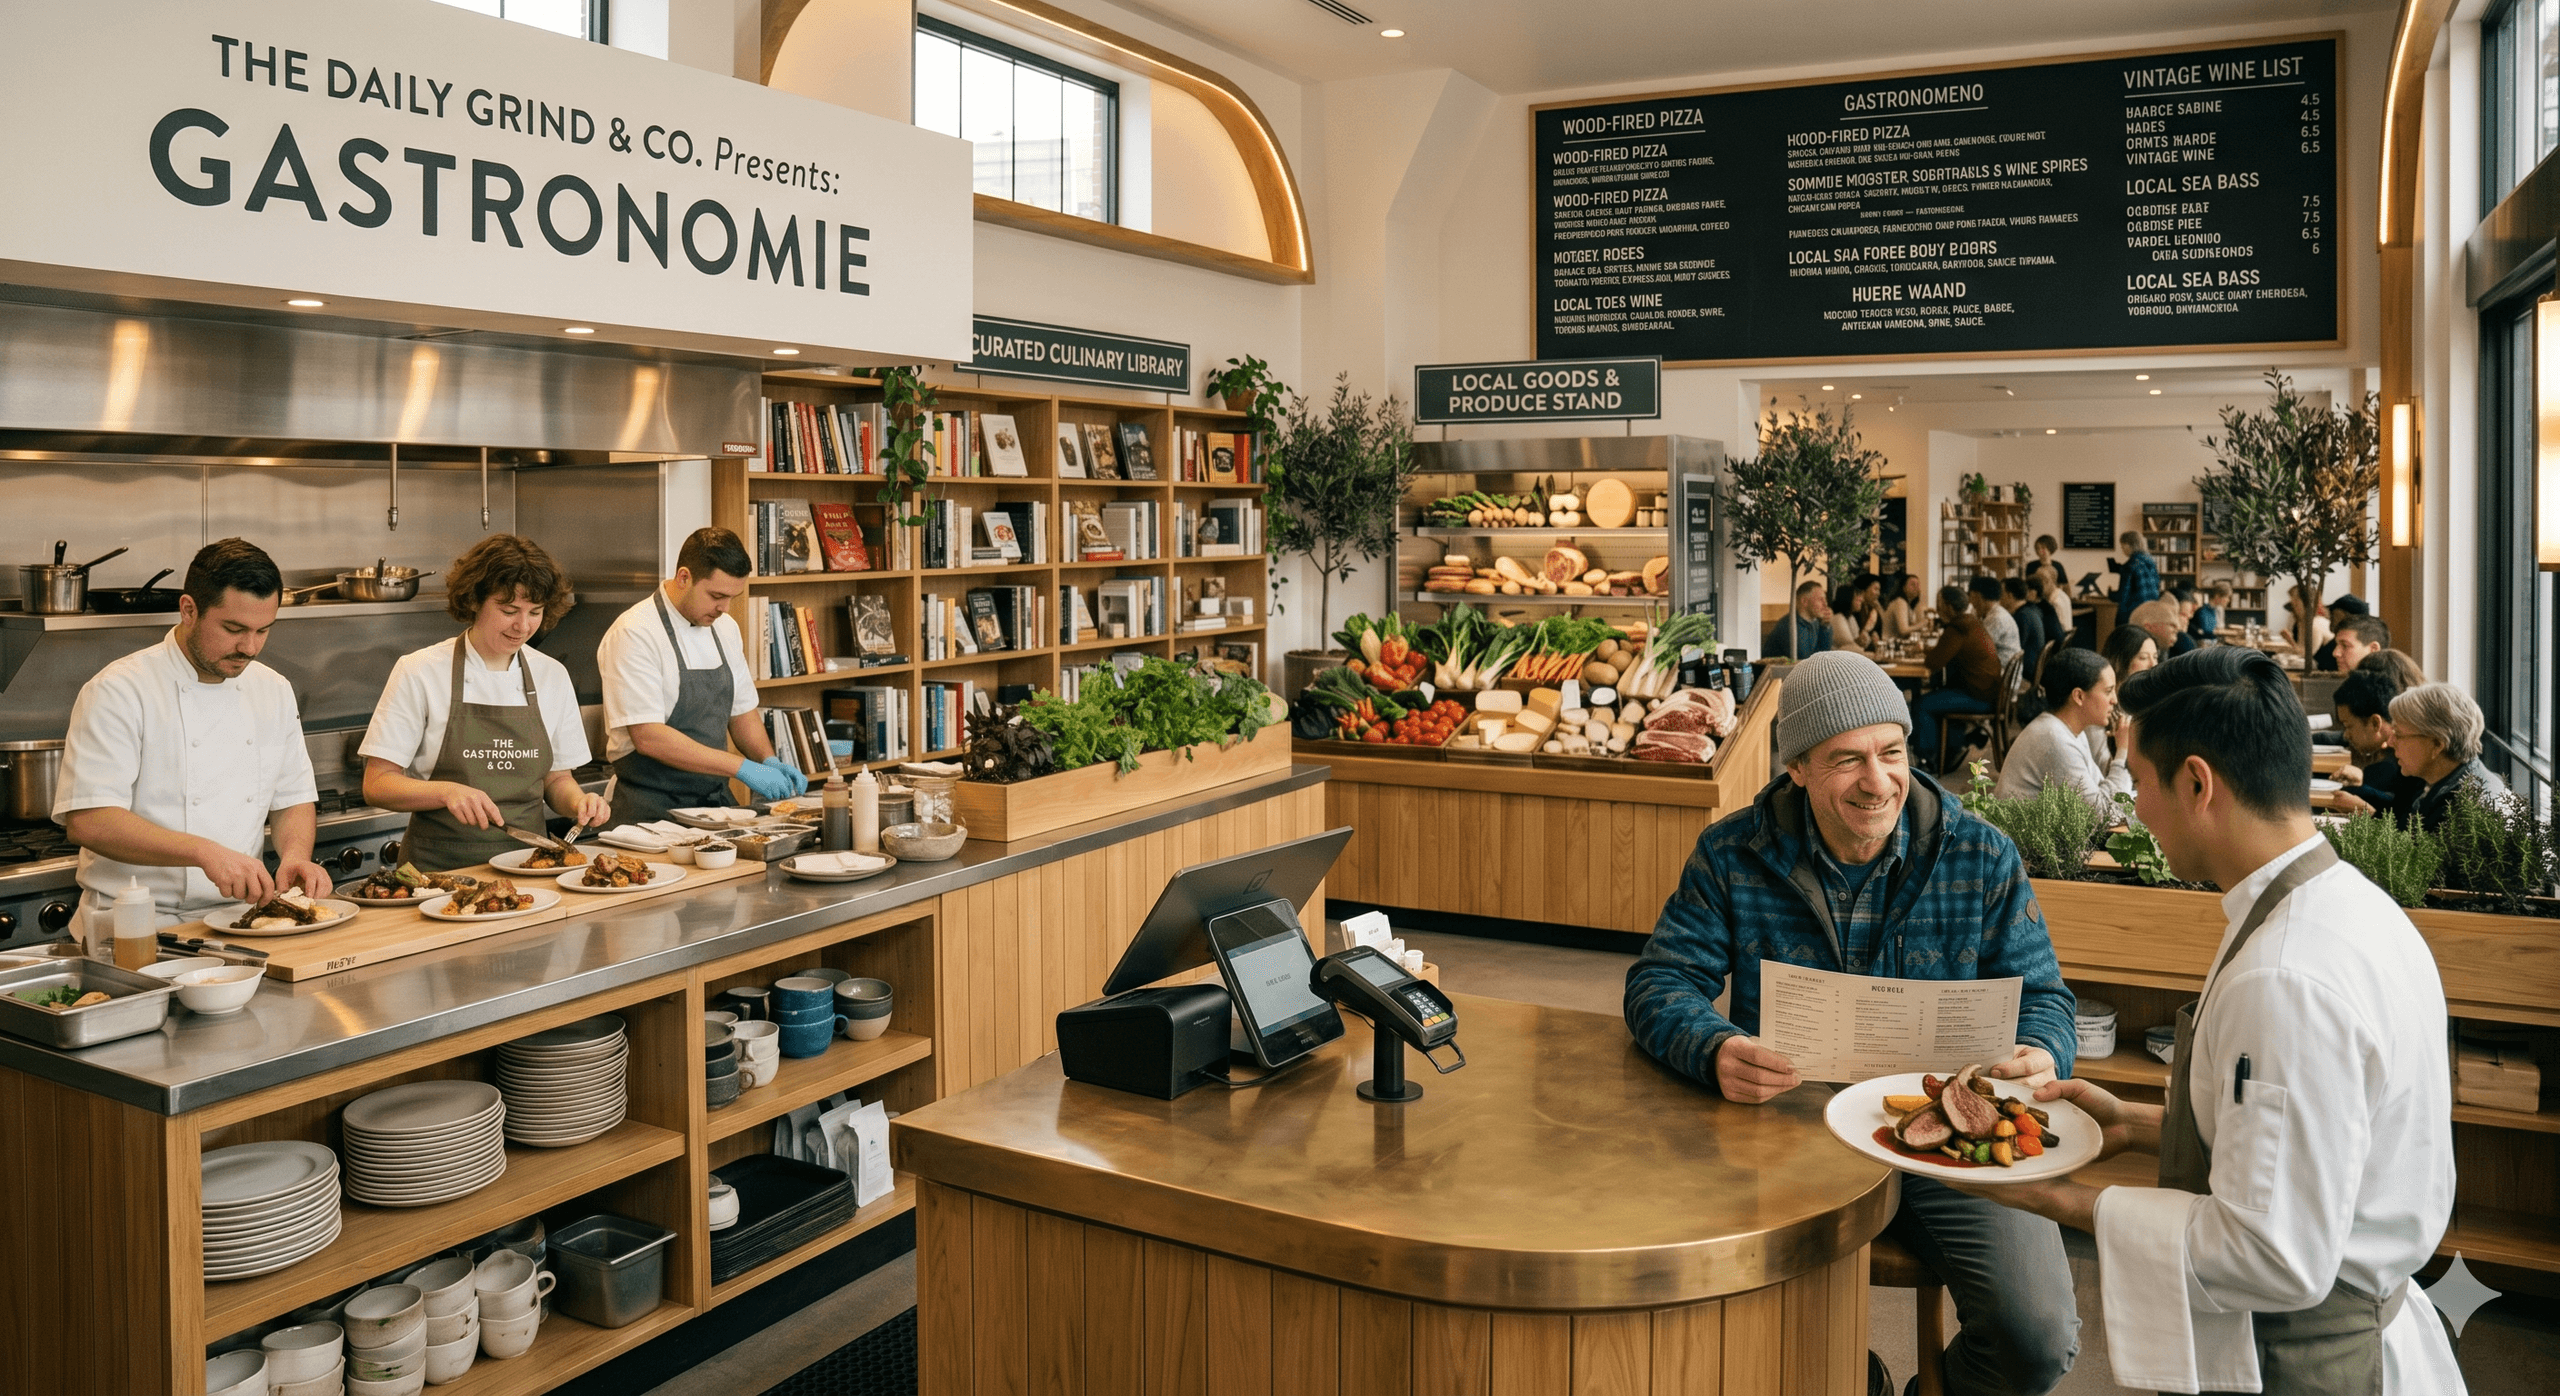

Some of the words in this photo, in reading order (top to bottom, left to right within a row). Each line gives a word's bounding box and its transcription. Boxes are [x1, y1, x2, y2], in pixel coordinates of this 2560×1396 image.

[2124, 66, 2201, 88] VINTAGE
[2209, 61, 2255, 81] WINE
[2264, 57, 2303, 77] LIST
[1845, 84, 1983, 111] GASTRONOMENO
[2301, 94, 2319, 105] 4.5
[212, 34, 308, 92] THE
[327, 59, 452, 119] DAILY
[466, 88, 596, 145] GRIND
[609, 116, 631, 152] &
[642, 124, 702, 166] CO.
[715, 137, 841, 195] Presents:
[2178, 100, 2221, 114] SABINE
[2301, 109, 2319, 121] 4.5
[1563, 113, 1654, 135] WOOD-FIRED
[1661, 109, 1703, 126] PIZZA
[1873, 125, 1910, 139] PIZZA
[2301, 125, 2319, 137] 6.5
[1553, 147, 1628, 164] WOOD-FIRED
[1633, 144, 1667, 158] PIZZA
[2302, 141, 2320, 153] 6.5
[2127, 151, 2178, 164] VINTAGE
[2183, 148, 2214, 161] WINE
[2006, 162, 2038, 175] WINE
[2043, 158, 2087, 173] SPIRES
[2127, 178, 2176, 195] LOCAL
[2182, 175, 2212, 191] SEA
[2218, 173, 2259, 189] BASS
[148, 107, 871, 296] GASTRONOMIE
[1554, 191, 1628, 207] WOOD-FIRED
[1633, 188, 1668, 202] PIZZA
[2303, 196, 2320, 207] 7.5
[2303, 211, 2320, 222] 7.5
[2302, 228, 2320, 239] 6.5
[1789, 250, 1830, 264] LOCAL
[1864, 246, 1905, 260] FOREE
[2313, 243, 2319, 254] 6
[2128, 274, 2177, 290] LOCAL
[2183, 272, 2213, 287] SEA
[2219, 270, 2259, 285] BASS
[1853, 285, 1902, 302] HUERE
[1908, 282, 1965, 299] WAAND
[1555, 298, 1592, 311] LOCAL
[1595, 296, 1626, 309] TOES
[1630, 294, 1662, 307] WINE
[1953, 305, 1981, 314] PAUCE,
[1955, 317, 1985, 326] SAUCE.
[973, 334, 1045, 362] CURATED
[1050, 343, 1124, 370] CULINARY
[1127, 352, 1183, 377] LIBRARY
[1453, 373, 1518, 391] LOCAL
[1524, 370, 1598, 389] GOODS
[1605, 369, 1619, 386] &
[1450, 394, 1547, 413] PRODUCE
[1553, 392, 1621, 410] STAND
[493, 739, 514, 748] THE
[462, 749, 539, 758] GASTRONOMIE
[487, 761, 494, 770] &
[497, 761, 515, 770] CO.
